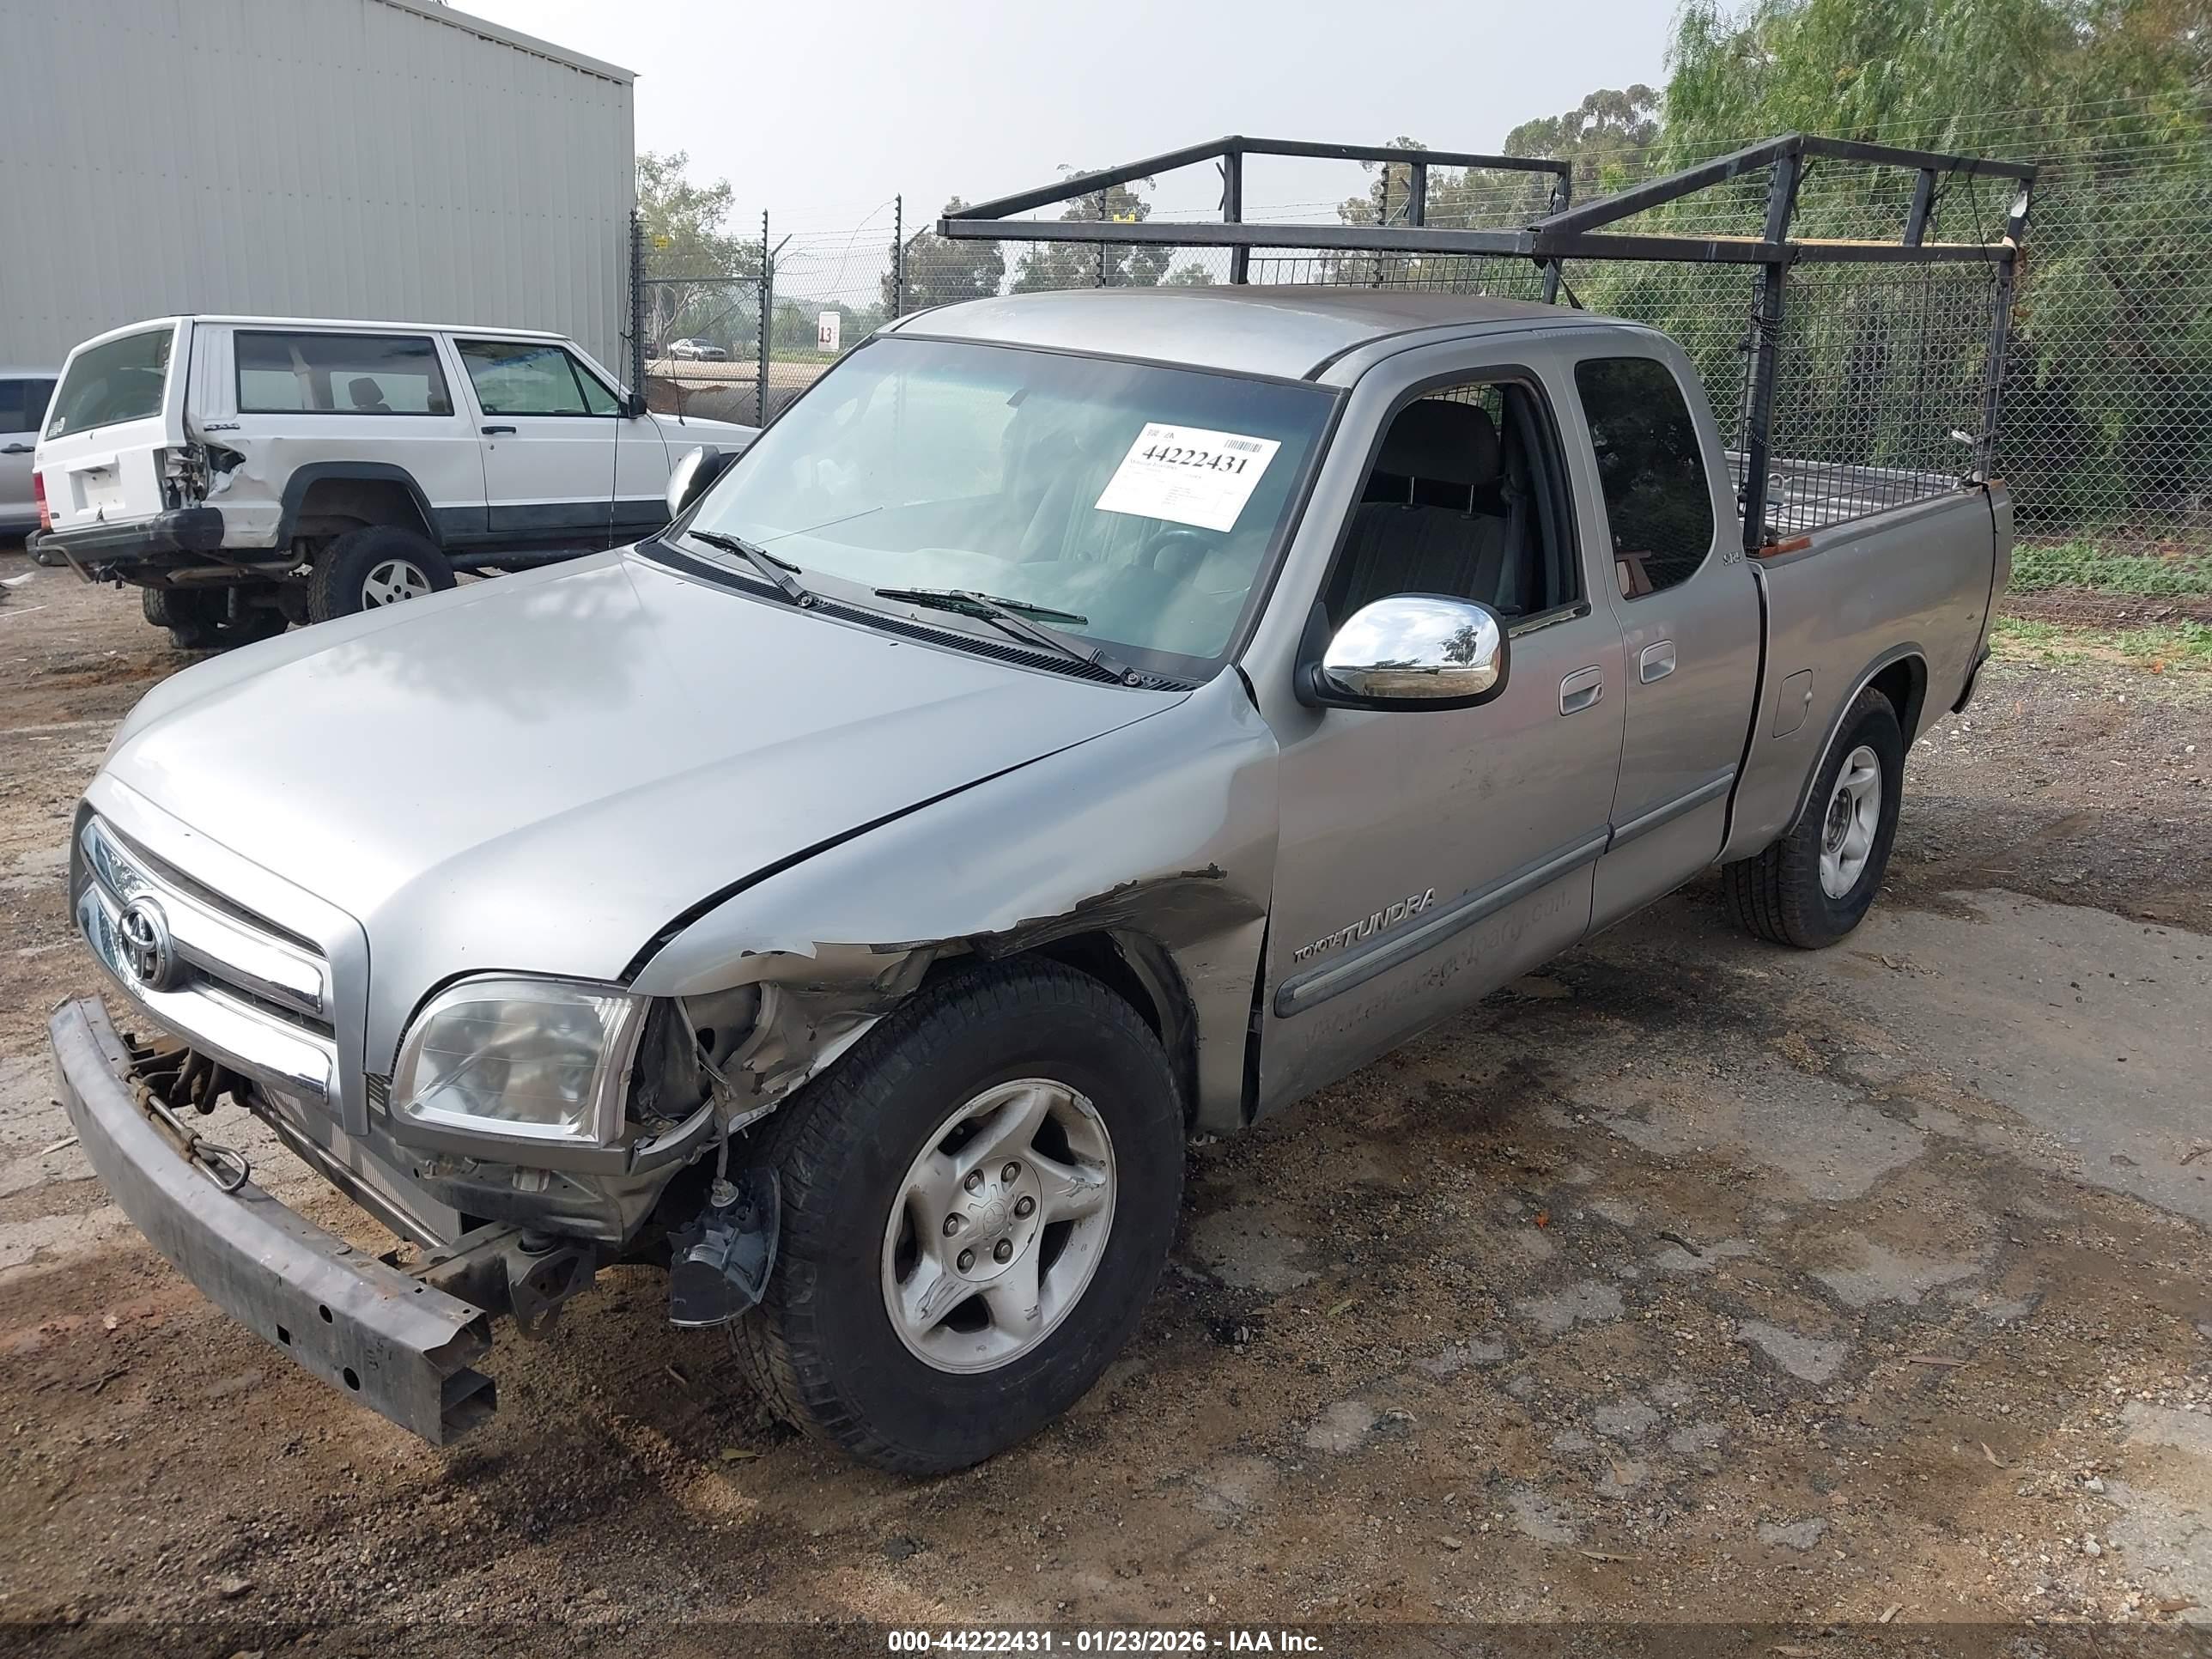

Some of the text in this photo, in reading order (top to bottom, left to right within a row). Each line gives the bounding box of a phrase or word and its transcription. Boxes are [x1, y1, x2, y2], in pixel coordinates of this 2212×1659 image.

[819, 326, 832, 343] 13
[1142, 444, 1249, 475] 44222431
[1293, 887, 1436, 963] TOYOTA TUNDRA
